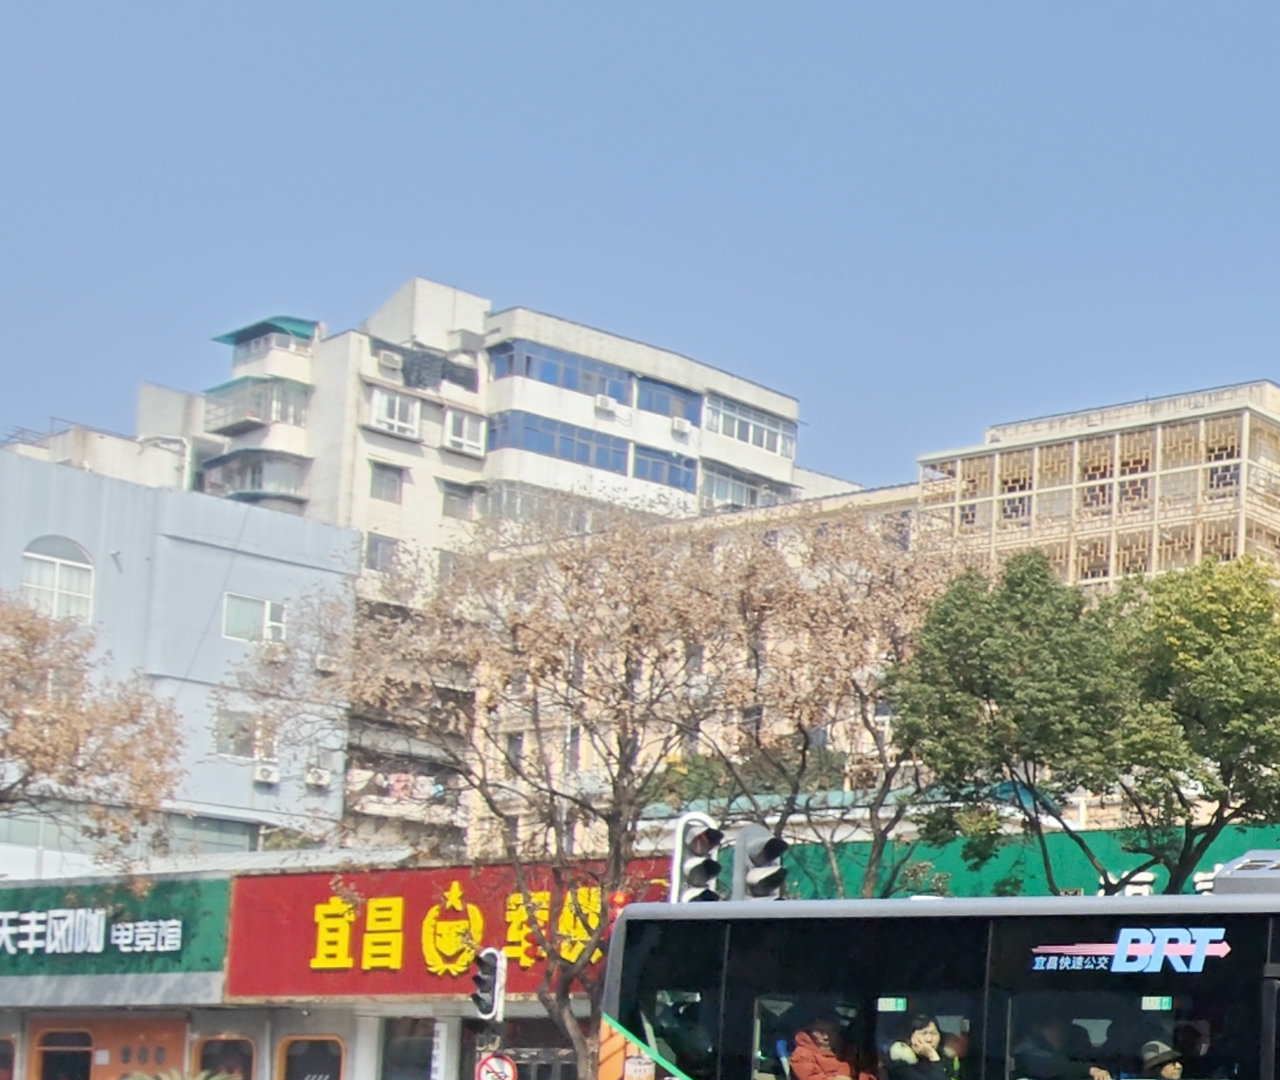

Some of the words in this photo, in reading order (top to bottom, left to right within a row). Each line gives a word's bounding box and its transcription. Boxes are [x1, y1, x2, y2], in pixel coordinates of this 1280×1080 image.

[110, 918, 182, 952] 电竞馆
[310, 896, 404, 970] 宜昌
[1032, 956, 1110, 970] 宜昌快速公交
